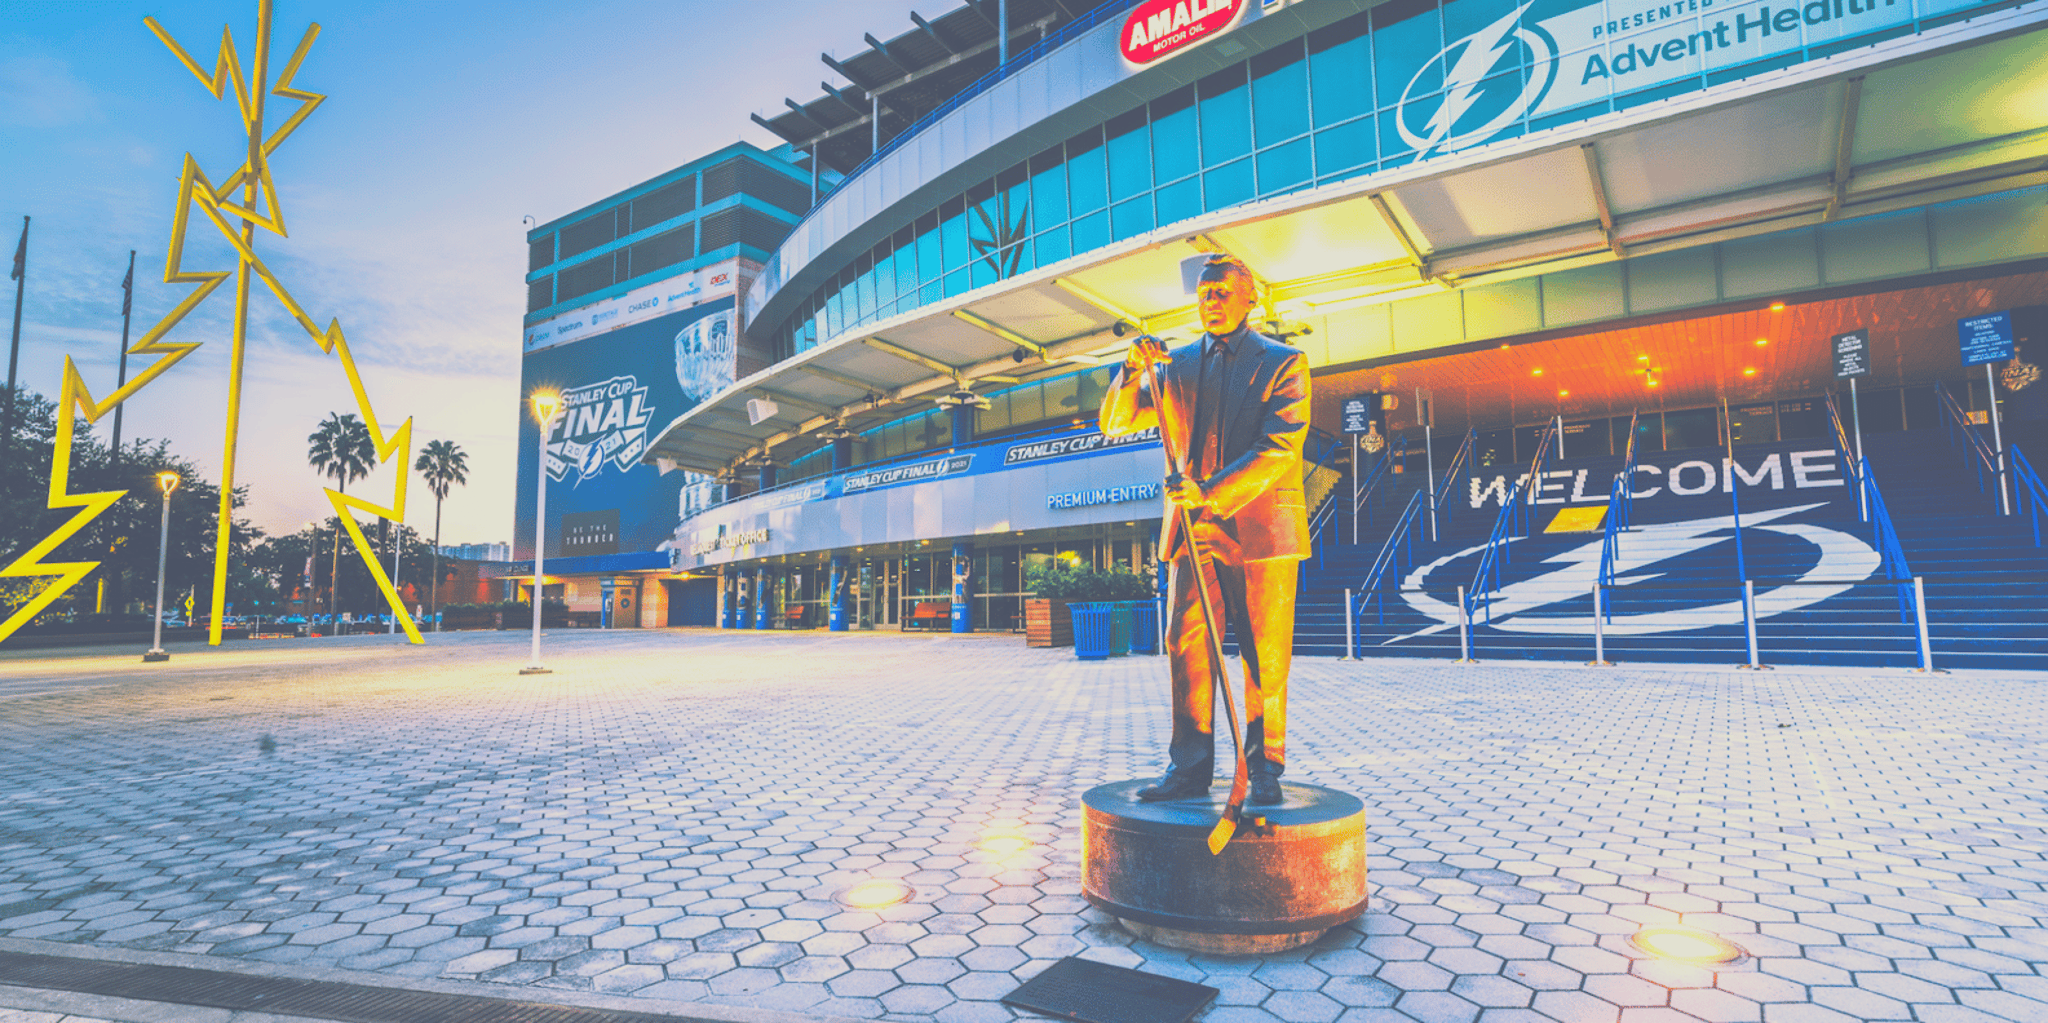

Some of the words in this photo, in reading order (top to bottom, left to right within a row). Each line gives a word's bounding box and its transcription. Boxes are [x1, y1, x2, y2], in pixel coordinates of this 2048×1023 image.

[1153, 30, 1187, 53] MOTOR
[1188, 22, 1206, 36] OIL
[628, 300, 651, 314] CHASE
[561, 386, 608, 410] STANLEY
[608, 381, 633, 399] CUP
[547, 394, 647, 443] FINAL
[567, 445, 581, 456] 20
[1008, 439, 1070, 462] STANLEY
[1069, 434, 1102, 452] CUP
[845, 473, 883, 491] STANLEY
[882, 470, 902, 483] CUP
[902, 464, 936, 479] FINAL
[1469, 448, 1844, 509] WELCOME
[741, 527, 768, 545] OFFICE
